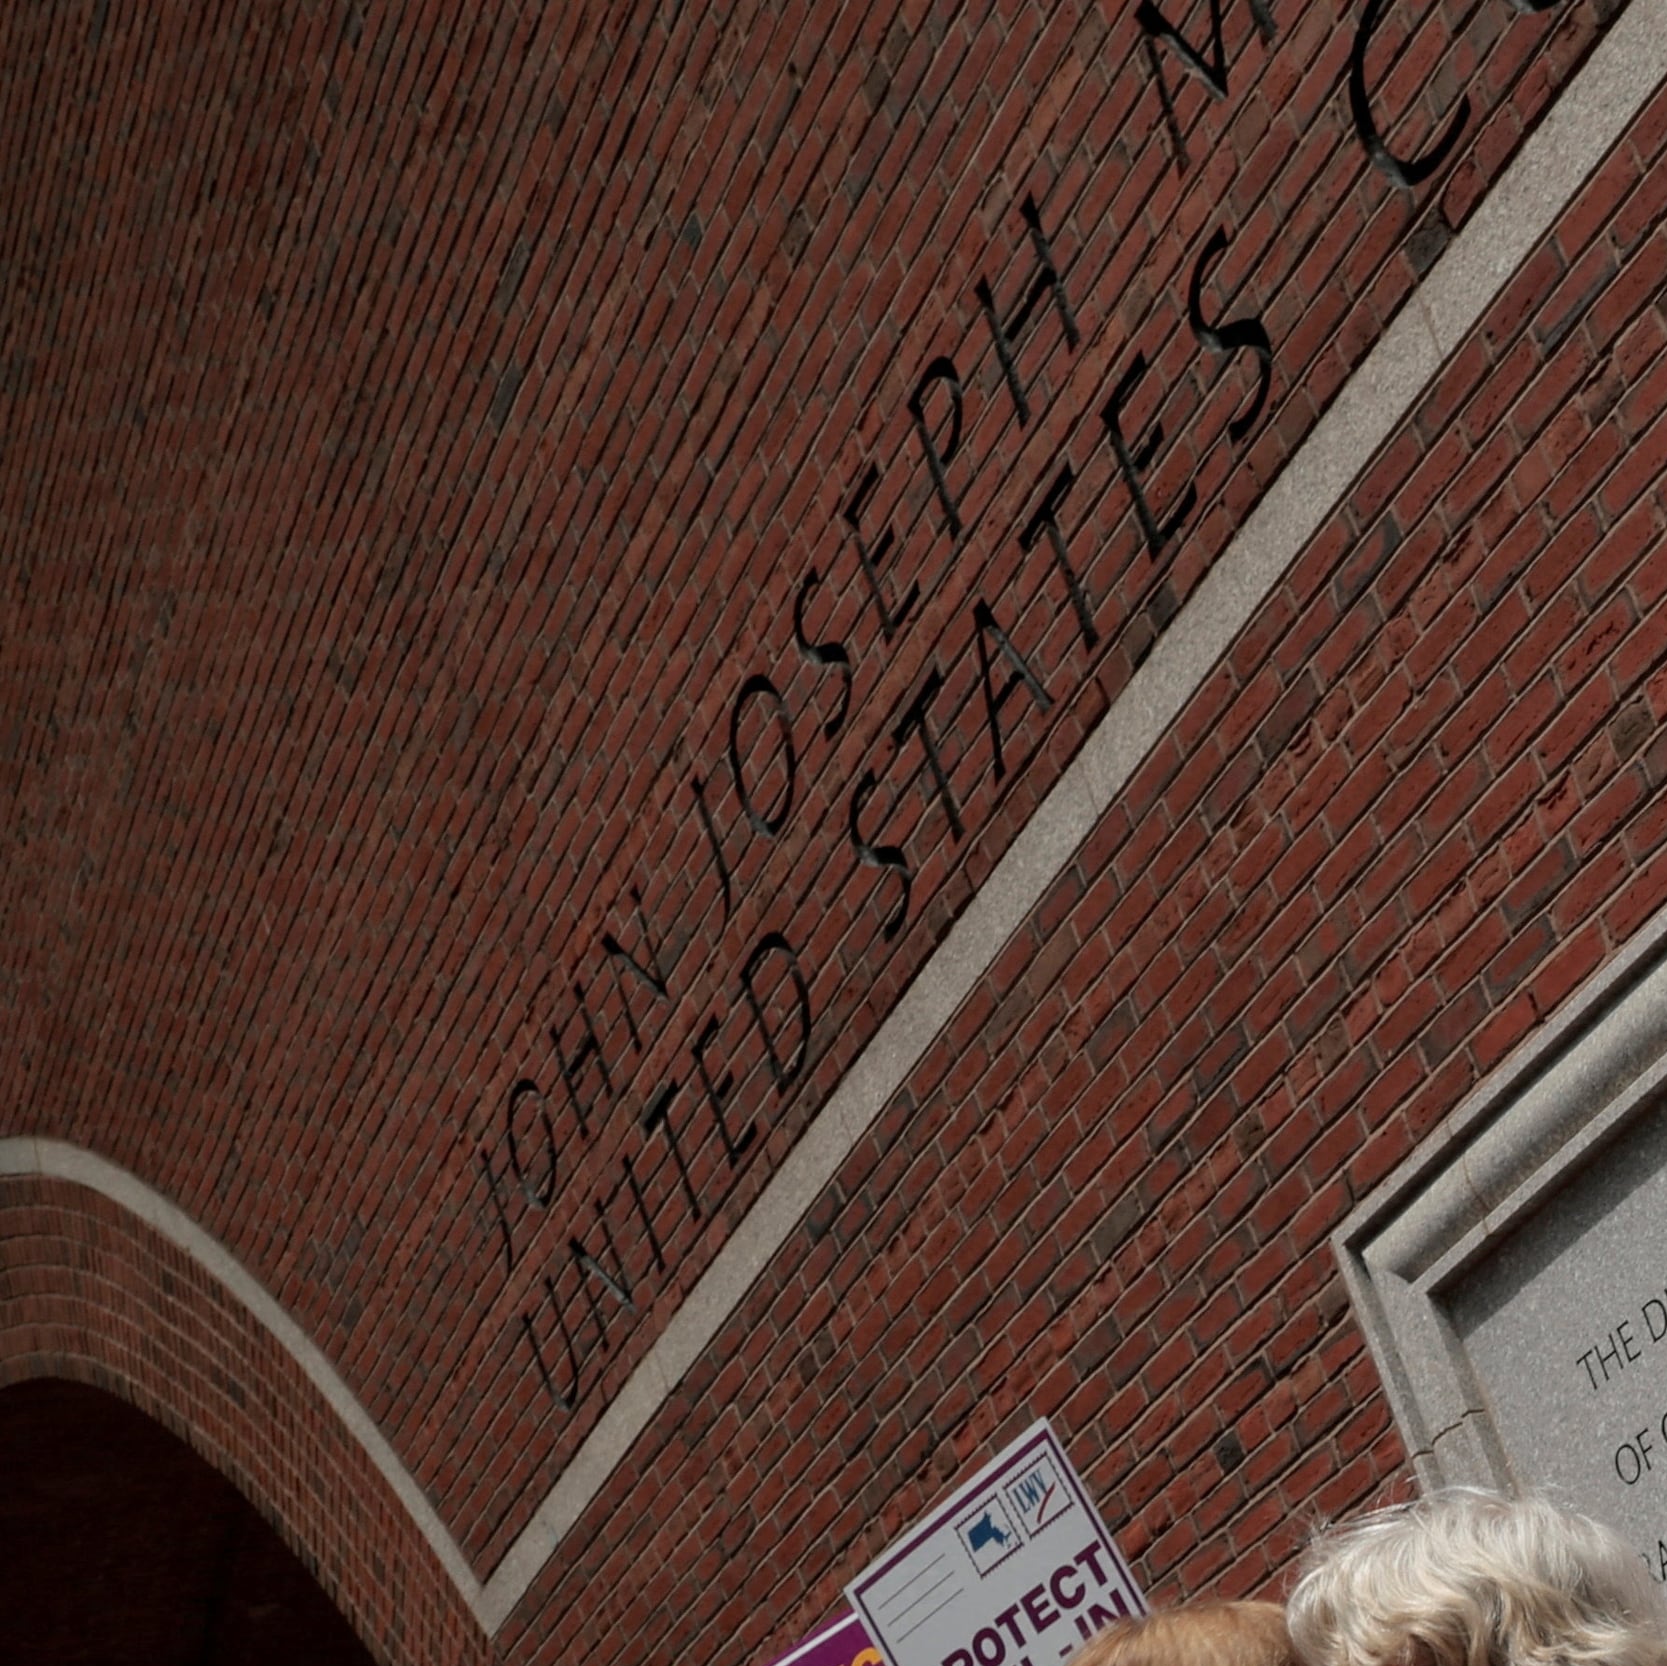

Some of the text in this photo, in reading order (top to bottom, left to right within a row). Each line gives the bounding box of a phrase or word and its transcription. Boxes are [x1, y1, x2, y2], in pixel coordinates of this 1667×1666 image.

[481, 193, 1080, 1274] JOHN JOSEPH
[522, 931, 812, 1411] UNITED
[847, 226, 1274, 940] STATES
[1576, 1320, 1642, 1390] THE
[1012, 1468, 1048, 1515] LWV
[1615, 1428, 1653, 1485] OF
